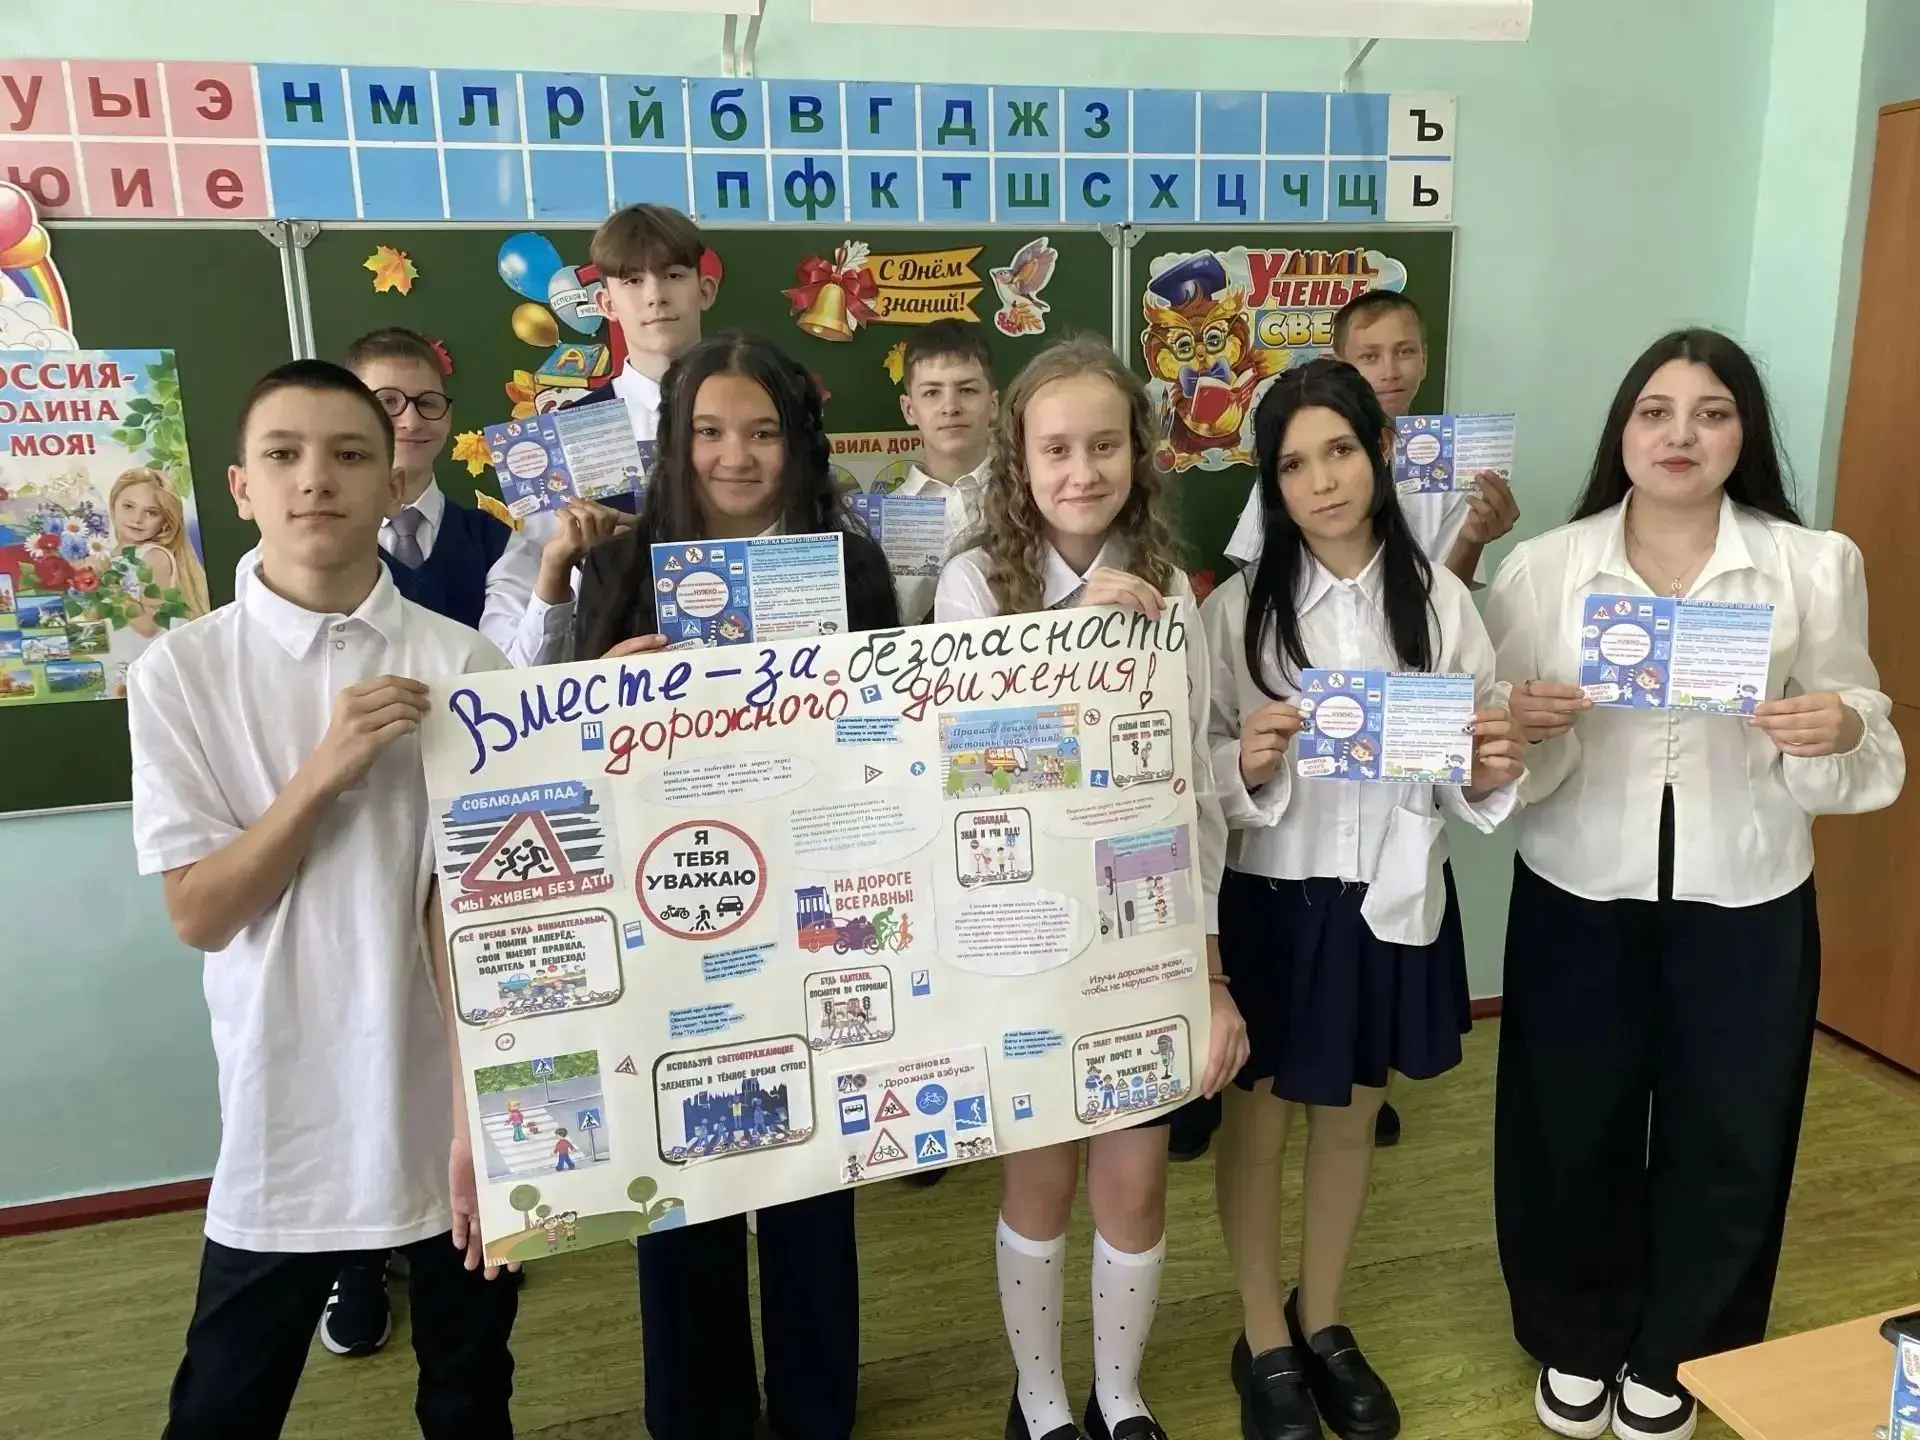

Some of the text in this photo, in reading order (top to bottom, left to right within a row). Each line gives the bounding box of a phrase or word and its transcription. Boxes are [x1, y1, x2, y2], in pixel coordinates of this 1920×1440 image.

[879, 259, 963, 282] С Днём
[881, 292, 966, 317] знаний!
[1260, 312, 1334, 346] СВЕ
[0, 363, 137, 390] ССИЯ-
[0, 399, 120, 424] ОДИНА
[11, 434, 96, 457] МОЯ!
[830, 436, 924, 455] ВИЛА ДОР
[449, 662, 692, 774] Вместе
[746, 644, 821, 708] за
[849, 603, 1187, 693] безопасность
[604, 652, 1157, 775] дорожного движения!
[462, 790, 540, 811] СОБЛЮДАЯ
[694, 830, 708, 845] Я
[673, 850, 729, 867] ТЕБЯ
[645, 869, 756, 890] УВАЖАЮ
[834, 871, 912, 893] НА ДОРОГЕ
[458, 874, 611, 912] МЫ ЖИВЕМ БЕЗ ДТП
[836, 889, 914, 911] ВСЕ РАВНЫ!
[479, 929, 507, 941] ВРЕМЯ
[511, 926, 533, 936] БУДЬ
[496, 937, 527, 949] ПОМНИ
[476, 953, 500, 963] СВОИ
[506, 947, 537, 960] ИМЕЮТ
[478, 962, 525, 976] ВОДИТЕЛЬ
[541, 952, 587, 966] ПЕШЕХОД!
[820, 976, 836, 986] БУДЬ
[1089, 973, 1116, 985] Изучи
[1117, 964, 1160, 980] дорожные
[1081, 984, 1109, 997] чтобы
[1110, 983, 1121, 991] не
[1122, 975, 1160, 989] нарушать
[666, 1044, 794, 1072] ИСПОЛЬЗУЙ СВЕТООТРАЖАЮЩИЕ
[898, 1057, 951, 1073] остановка
[660, 1077, 703, 1091] ЭЛЕМЕНТЫ
[717, 1070, 747, 1082] ТЁМНОЕ
[750, 1066, 776, 1077] ВРЕМЯ
[780, 1061, 807, 1072] СУТОК!
[937, 1065, 975, 1078] азбука»
